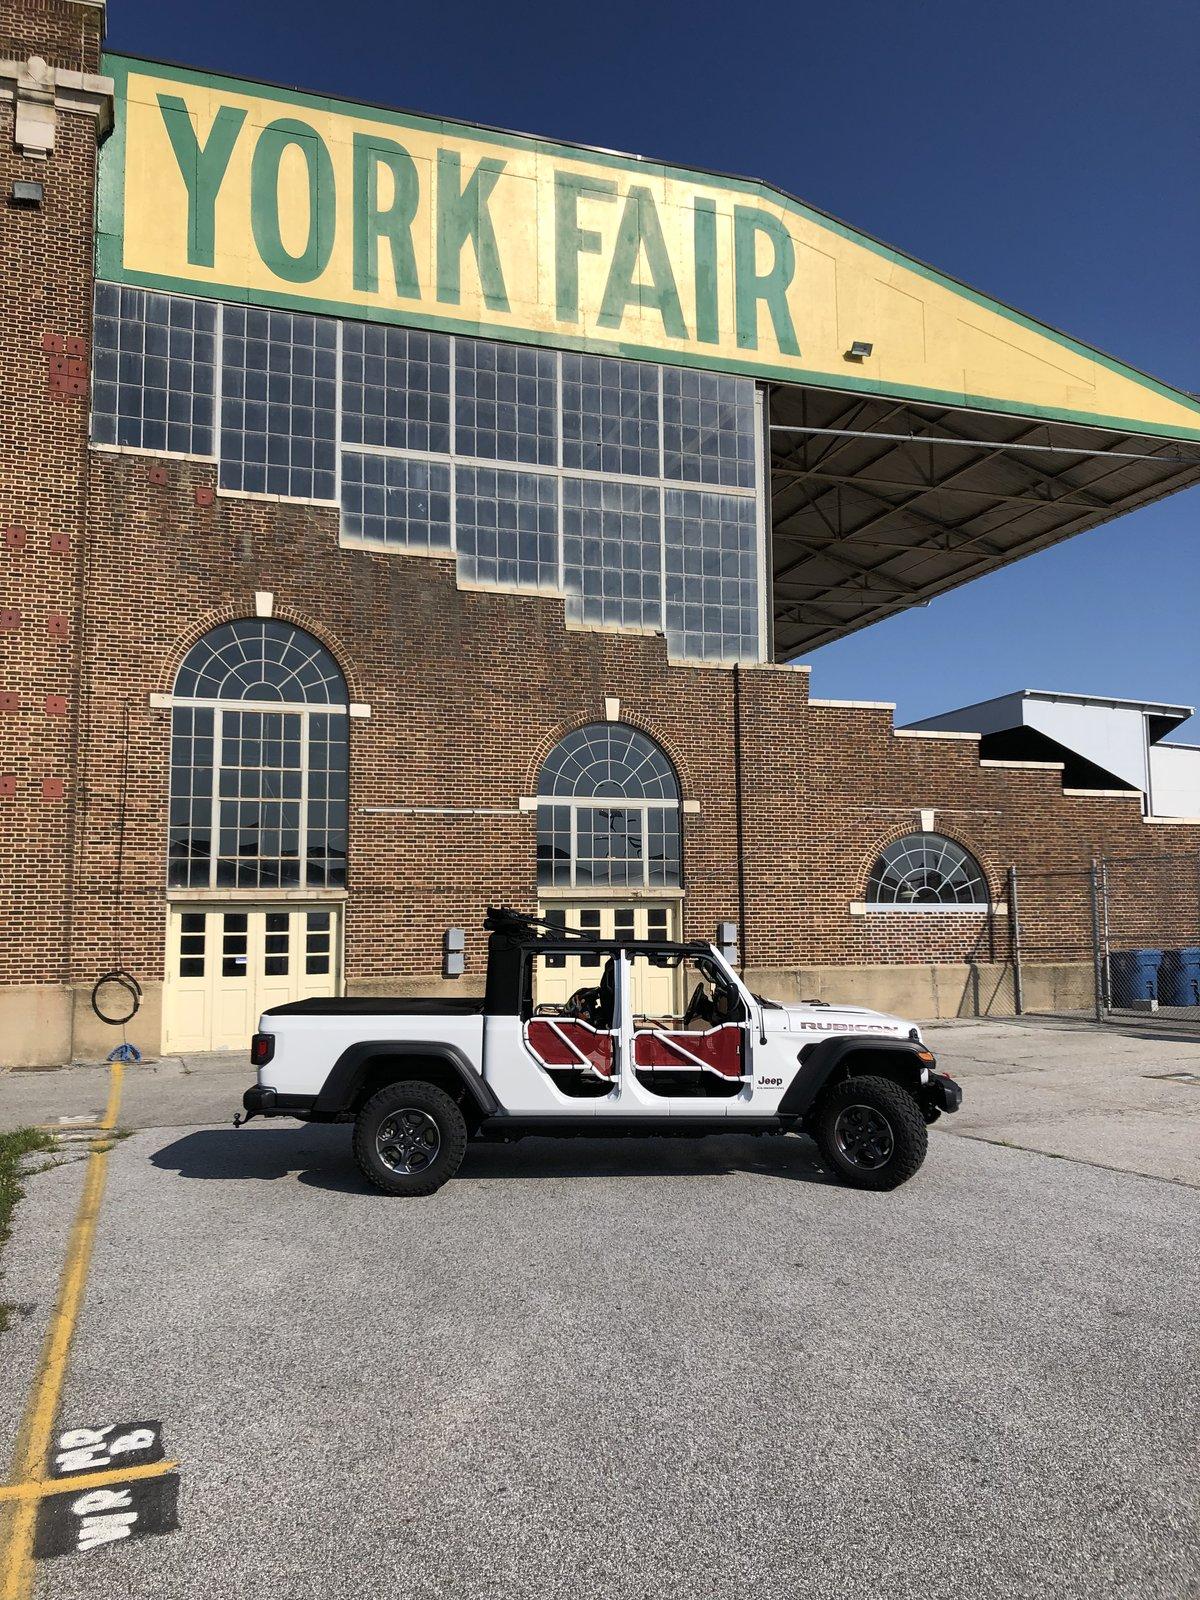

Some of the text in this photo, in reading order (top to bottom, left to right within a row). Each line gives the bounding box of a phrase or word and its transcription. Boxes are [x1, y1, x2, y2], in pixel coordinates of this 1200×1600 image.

[156, 92, 802, 358] YORK FAIR
[800, 1021, 898, 1034] RUBICON
[758, 1075, 783, 1086] Jeep
